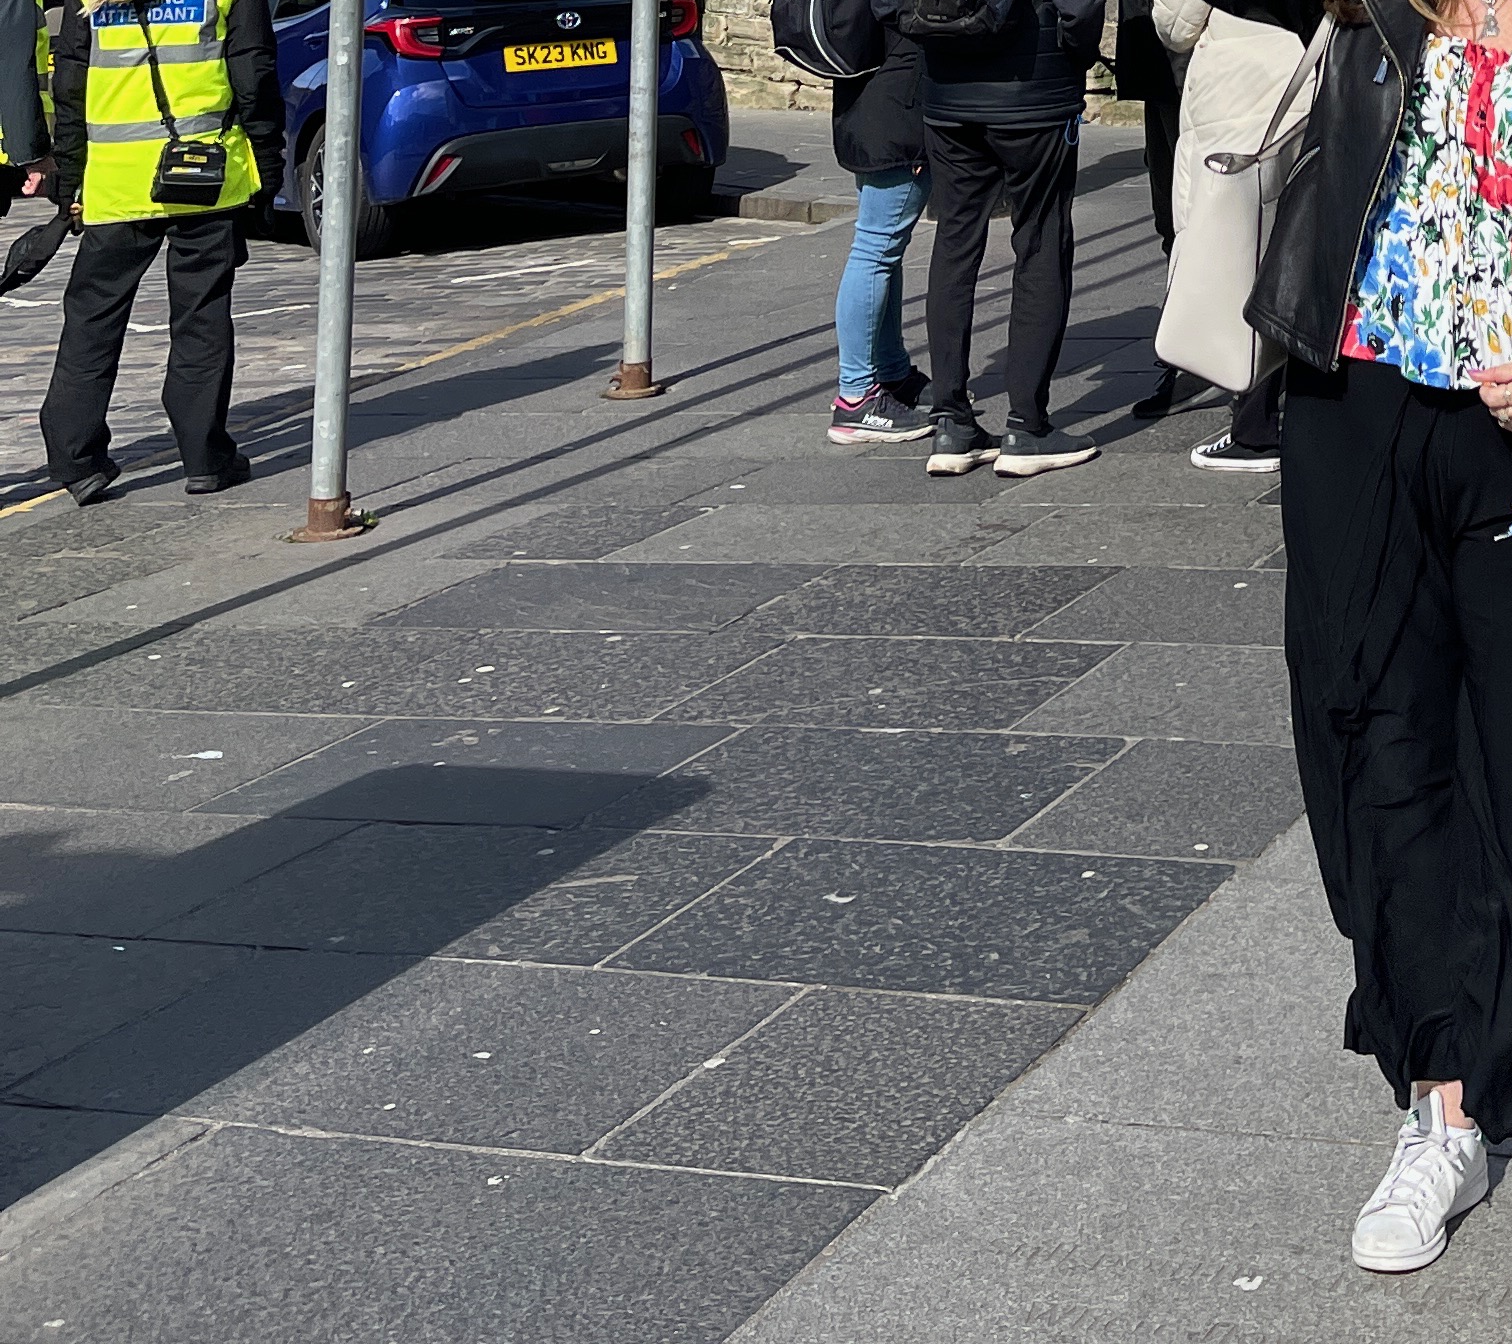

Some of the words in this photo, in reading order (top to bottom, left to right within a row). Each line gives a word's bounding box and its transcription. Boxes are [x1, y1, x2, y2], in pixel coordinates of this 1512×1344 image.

[97, 6, 199, 24] ATTEDANT
[513, 44, 566, 66] SK23
[569, 41, 608, 62] KNG
